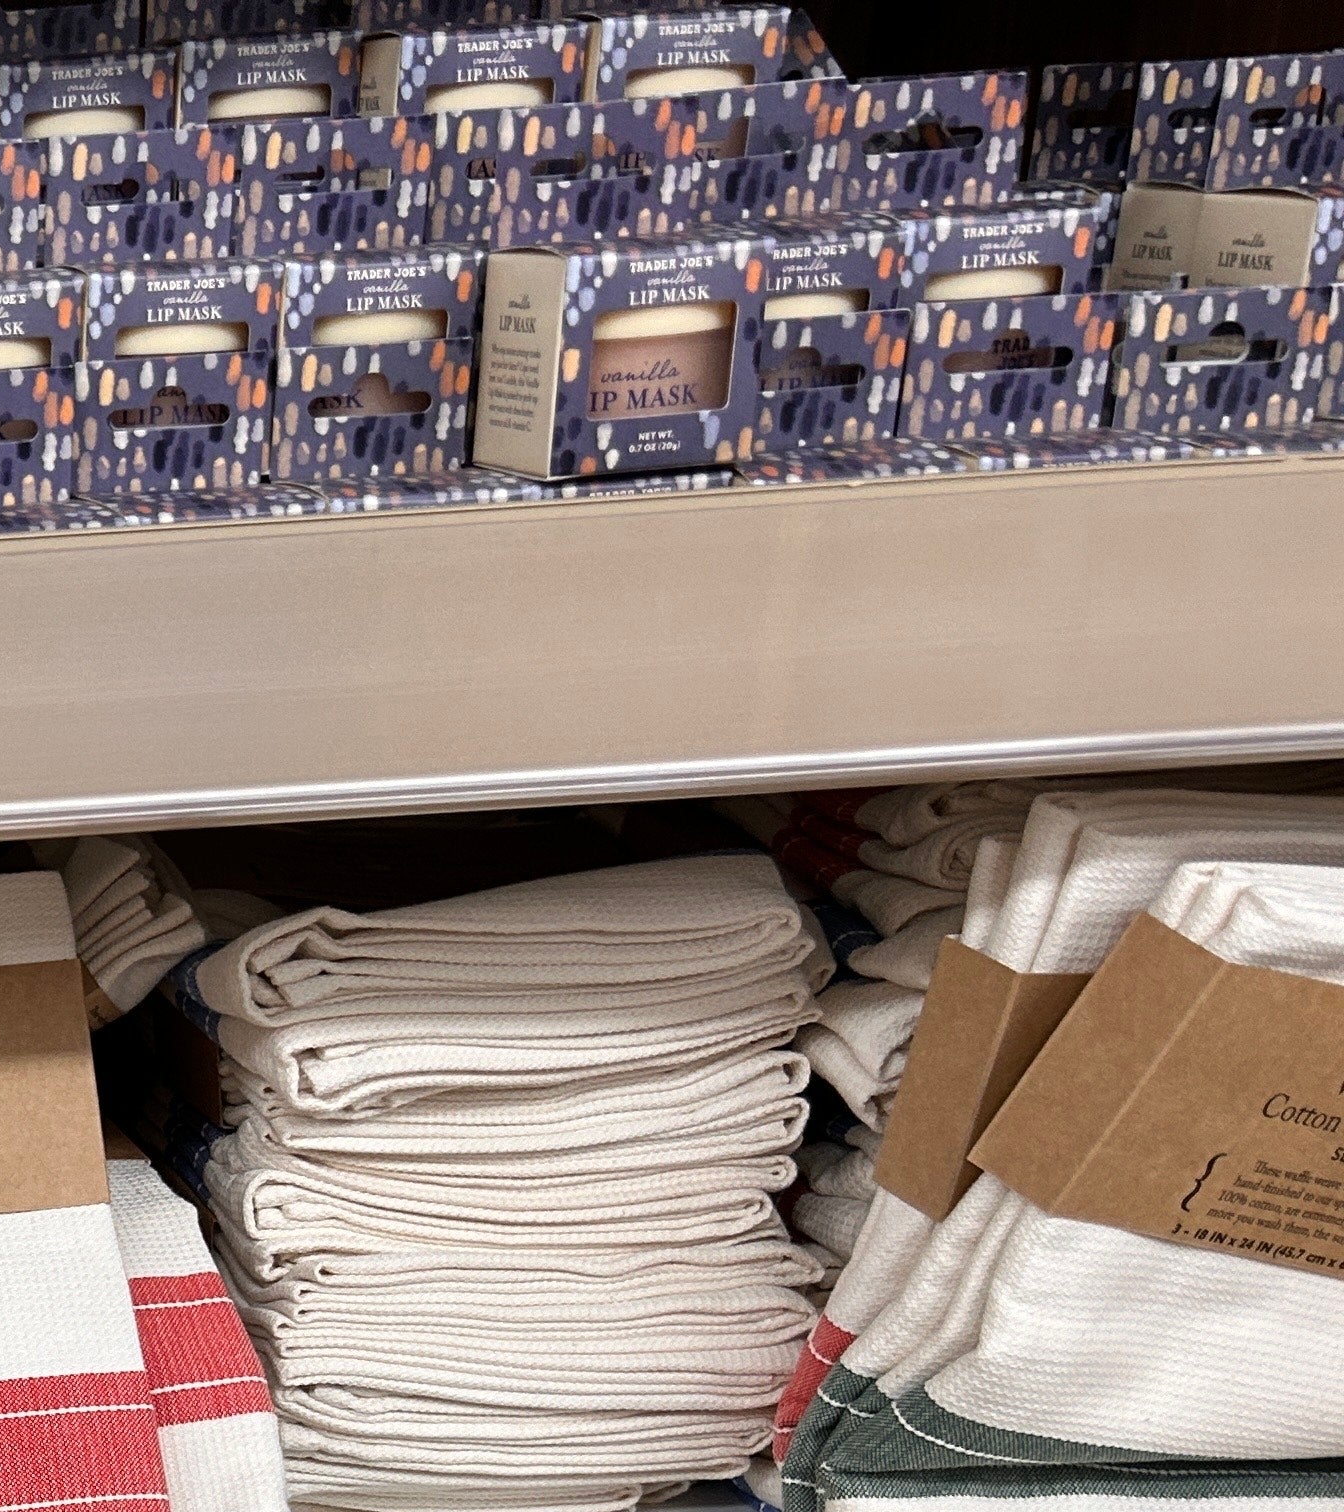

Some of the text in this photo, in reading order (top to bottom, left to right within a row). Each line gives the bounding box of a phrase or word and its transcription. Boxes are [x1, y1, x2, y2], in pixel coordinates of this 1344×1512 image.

[630, 259, 676, 274] TRADER
[647, 270, 695, 286] vanilla
[629, 285, 710, 306] LIP MASK
[601, 359, 680, 383] vanilla
[627, 383, 697, 410] MASK
